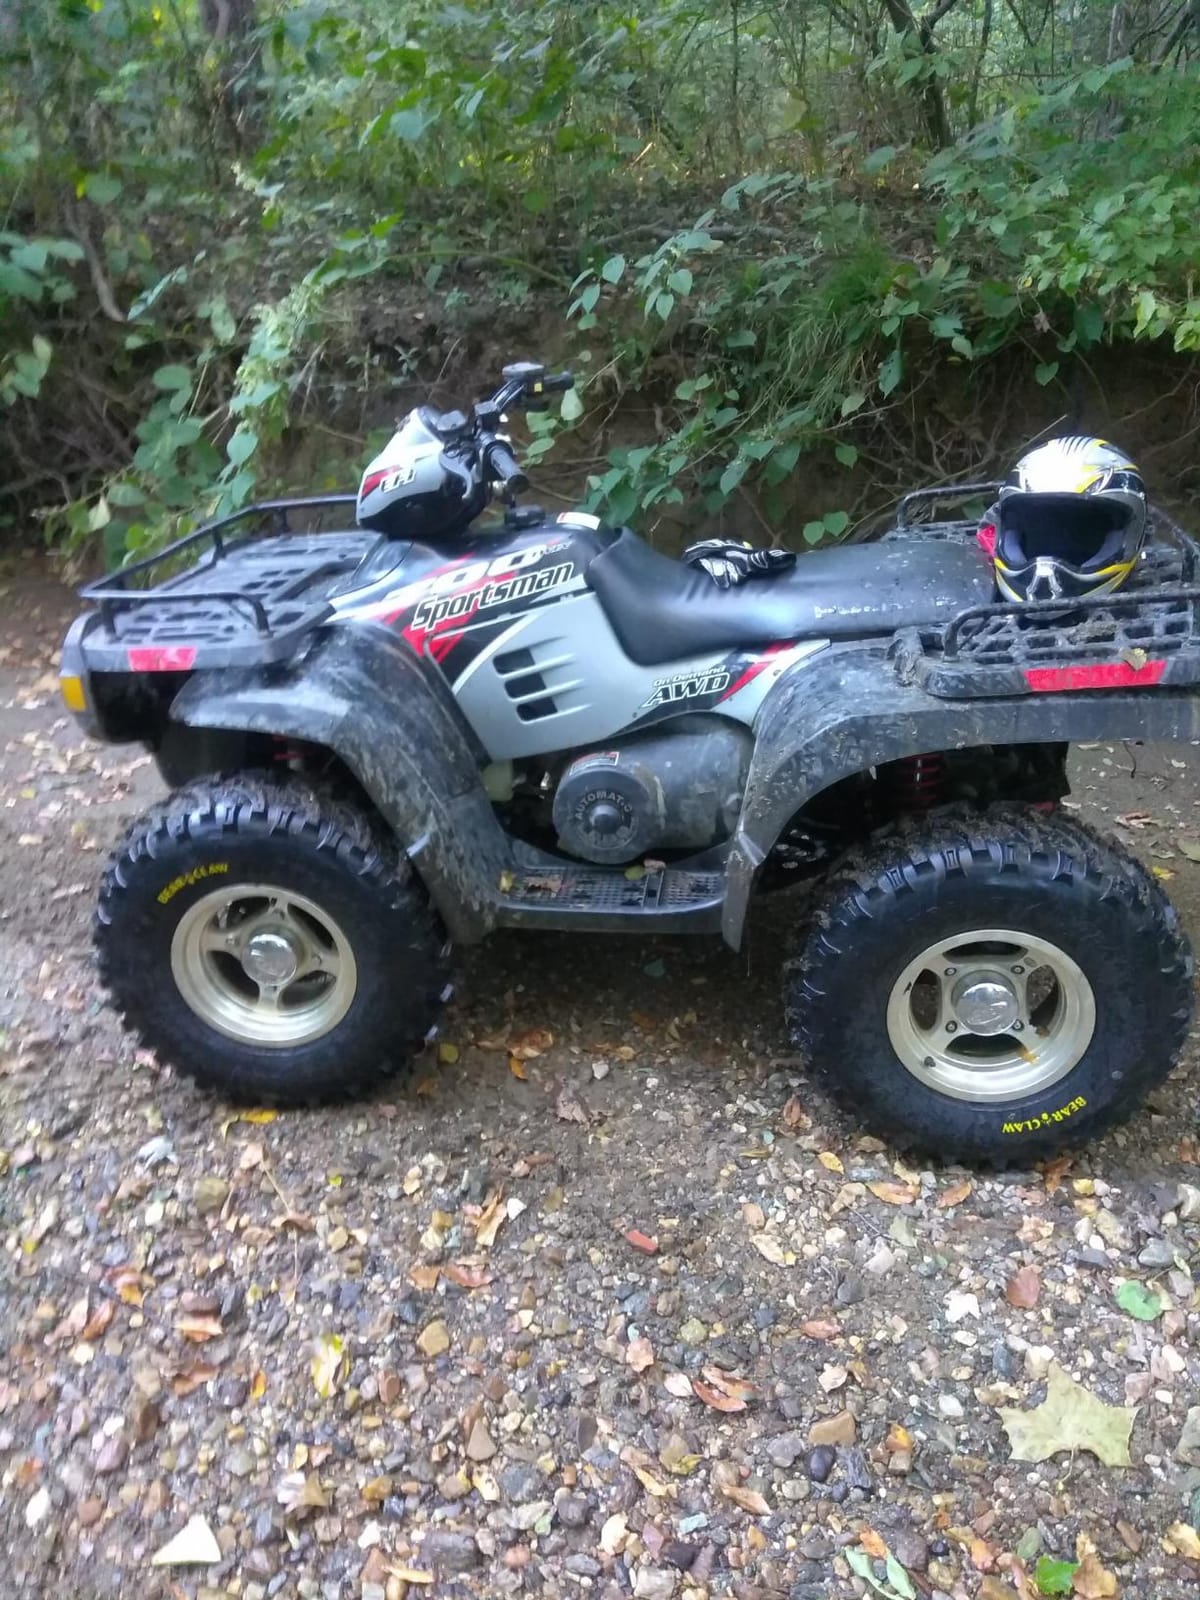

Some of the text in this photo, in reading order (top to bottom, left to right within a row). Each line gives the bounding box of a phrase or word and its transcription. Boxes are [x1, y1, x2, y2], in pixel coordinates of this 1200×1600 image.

[411, 562, 574, 631] Sportsman
[641, 672, 730, 708] AWD
[1002, 1096, 1087, 1133] BEAR CLAW
